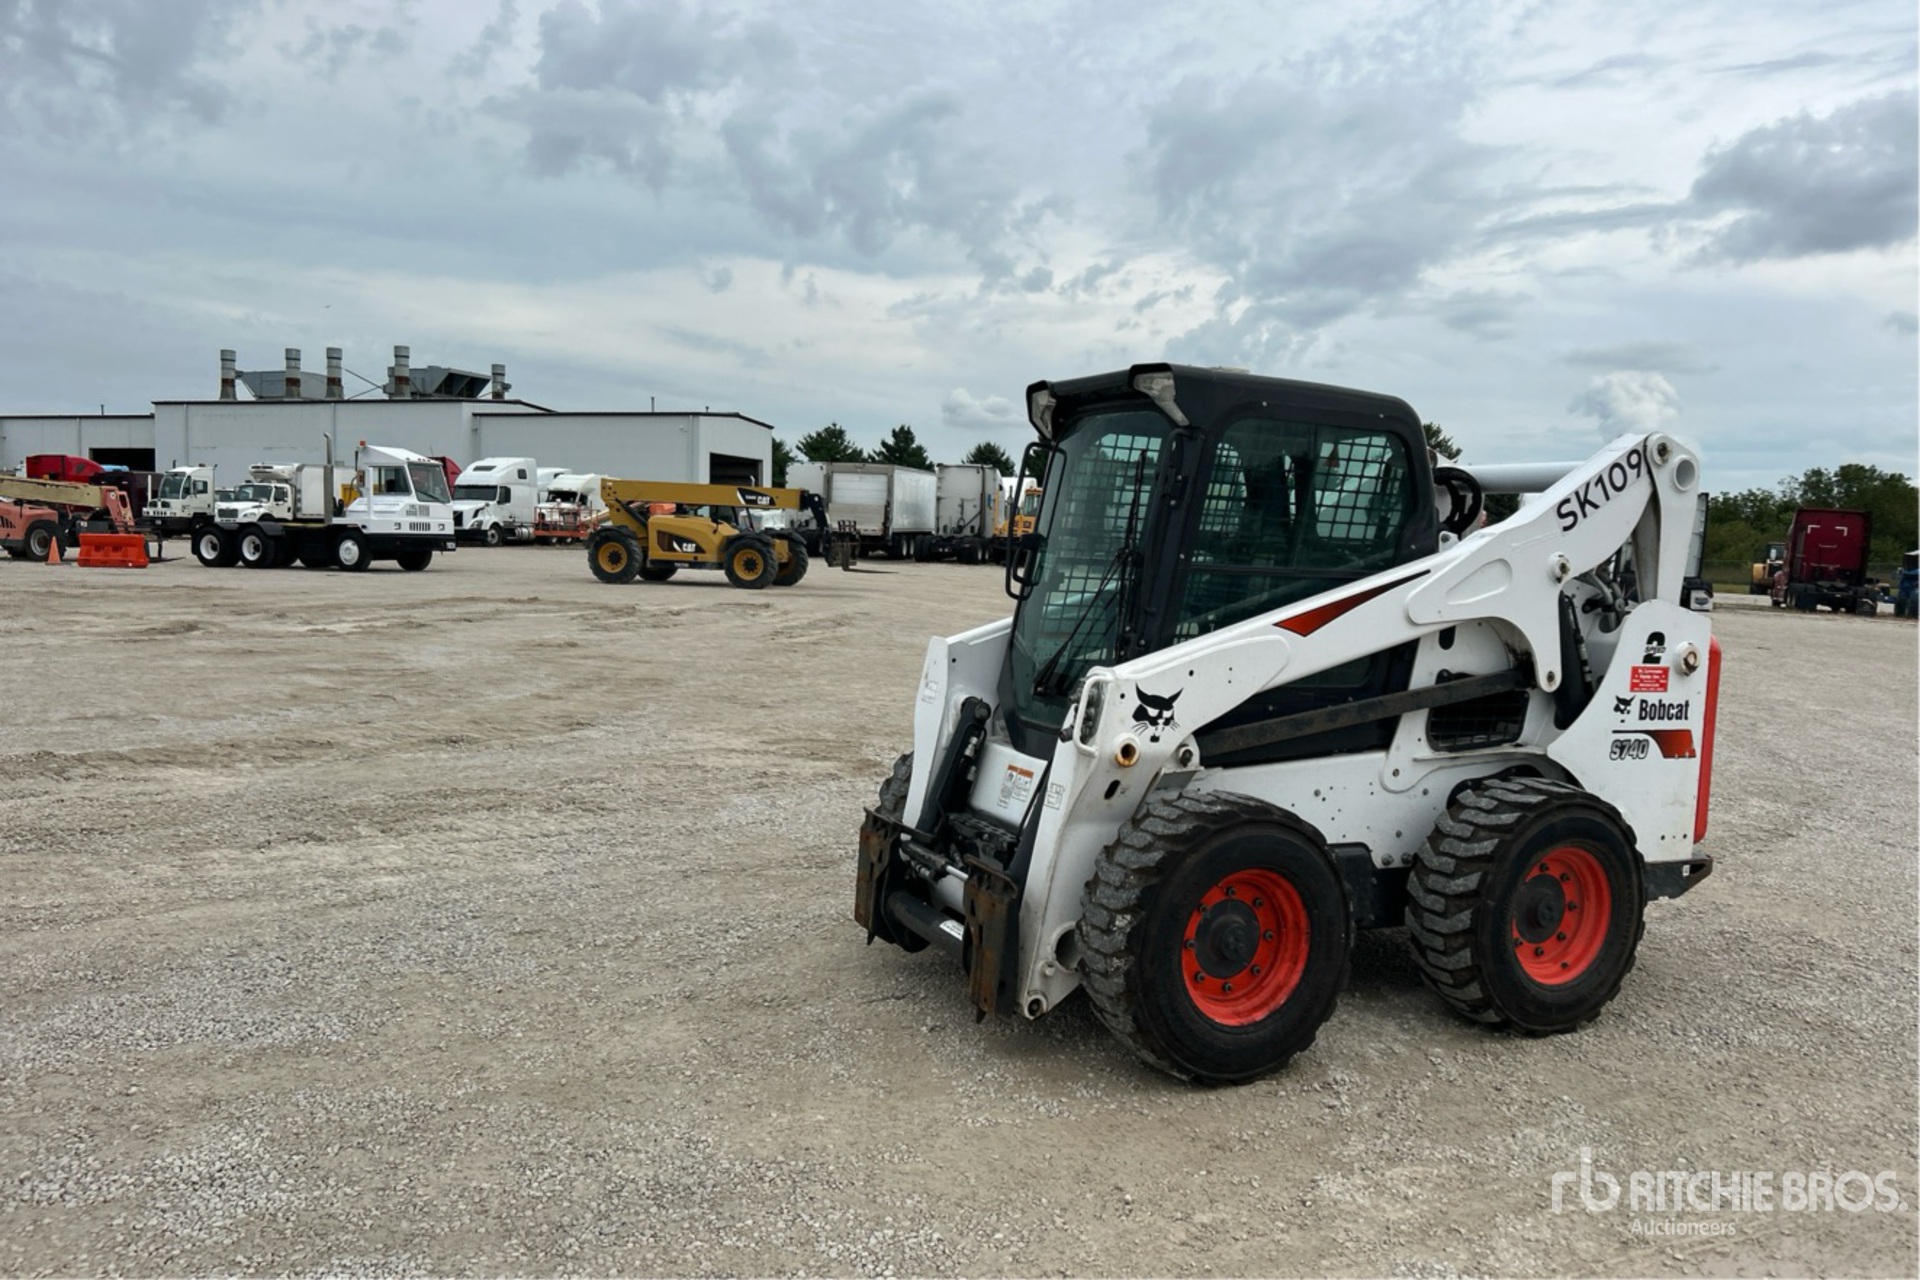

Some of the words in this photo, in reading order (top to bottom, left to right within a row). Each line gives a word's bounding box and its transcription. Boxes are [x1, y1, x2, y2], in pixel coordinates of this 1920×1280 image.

[757, 496, 770, 505] CAT
[1557, 448, 1641, 532] SK109
[682, 542, 696, 552] CAT
[1642, 631, 1665, 664] 2
[1639, 699, 1689, 721] Bobcat
[1609, 738, 1650, 761] S740
